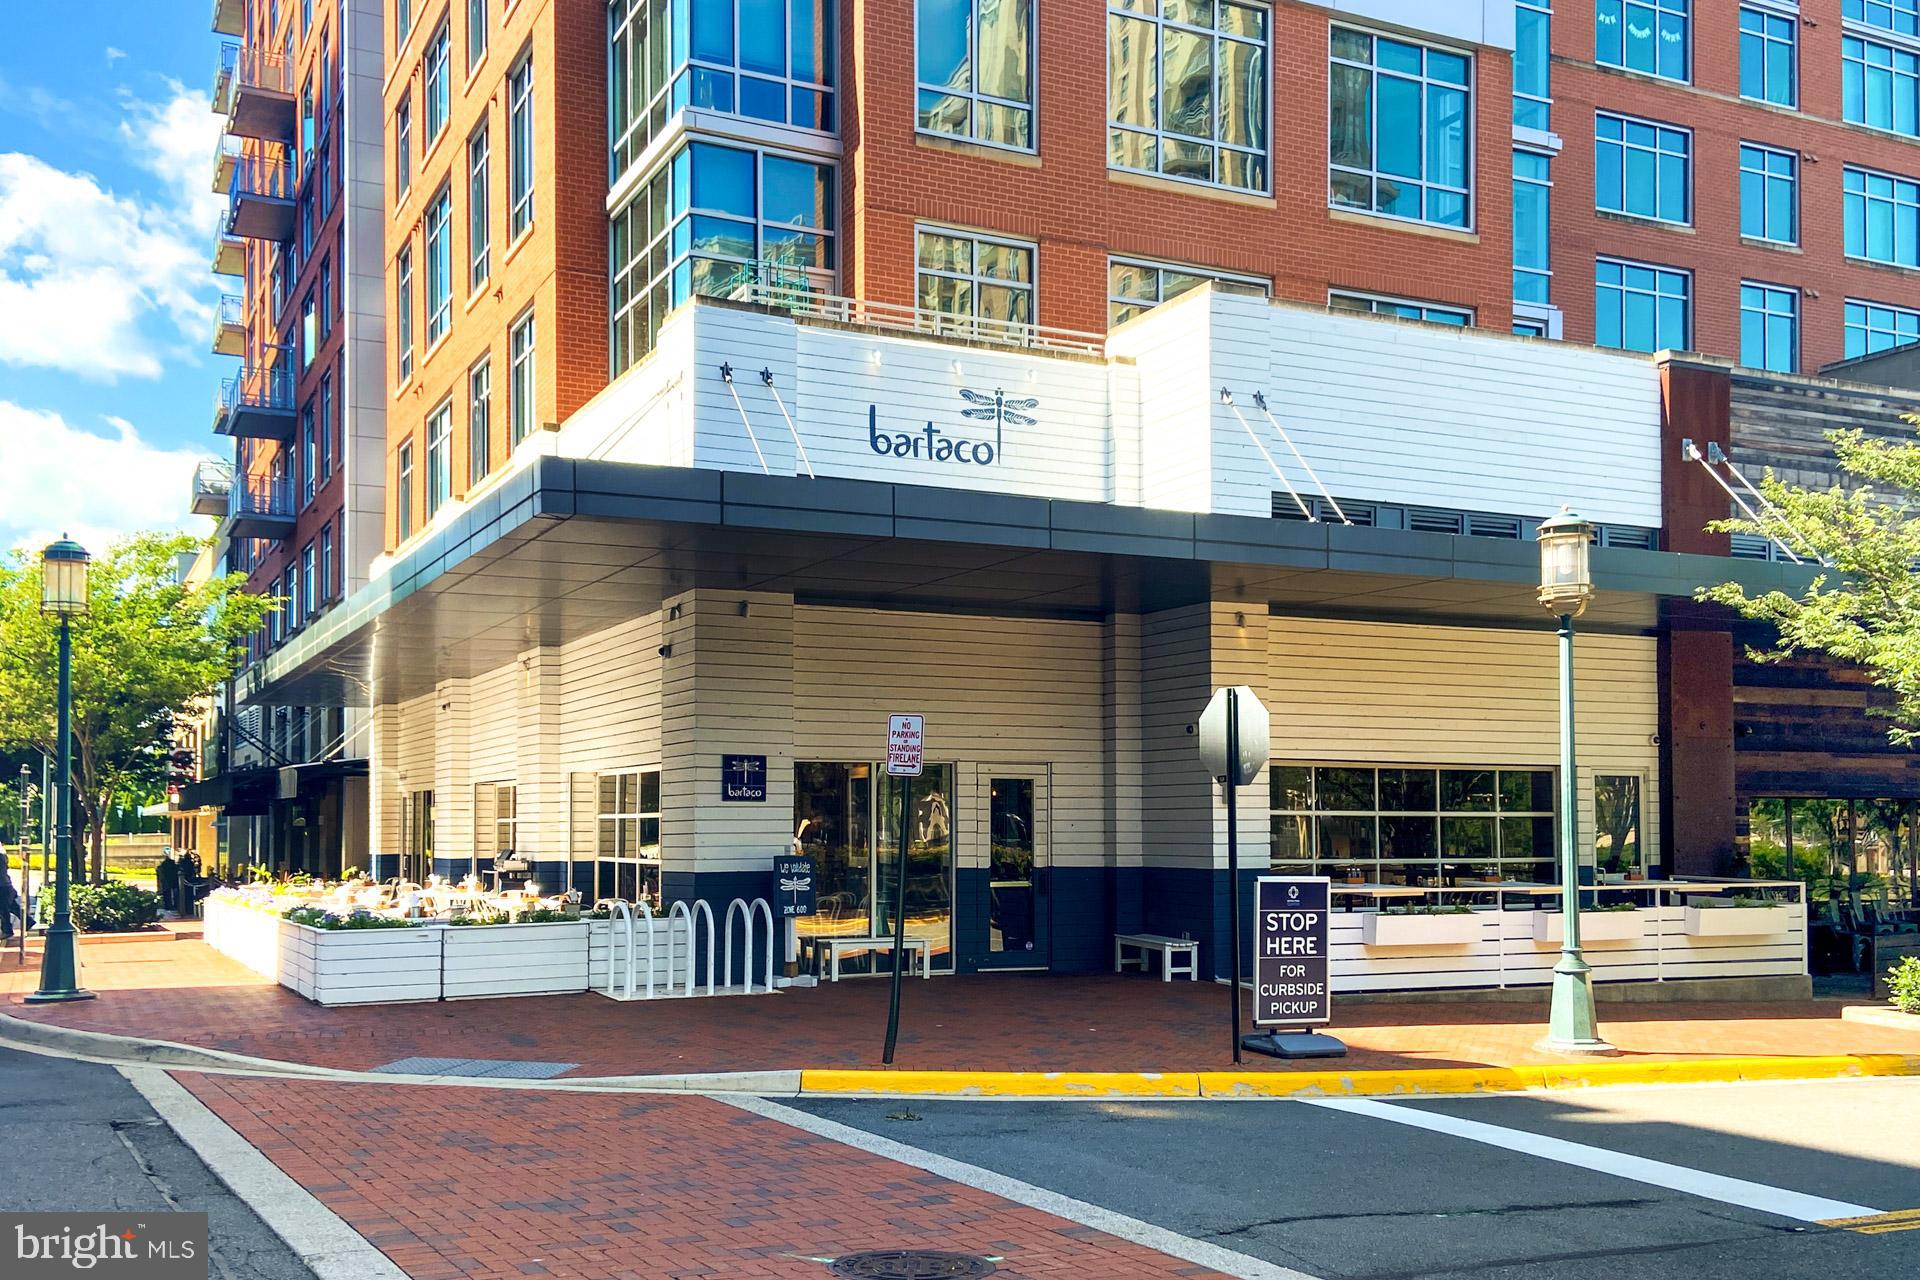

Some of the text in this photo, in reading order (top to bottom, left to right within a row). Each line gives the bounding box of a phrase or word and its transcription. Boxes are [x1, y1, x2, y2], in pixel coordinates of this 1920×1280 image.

[869, 404, 994, 465] bartaco
[901, 721, 911, 730] NO
[891, 730, 920, 739] PARKING
[889, 744, 921, 752] STANDING
[889, 753, 920, 763] FIRELANE
[728, 782, 762, 797] bartaco
[1266, 912, 1318, 932] STOP
[1266, 936, 1318, 956] HERE
[1279, 964, 1306, 978] FOR
[1260, 982, 1324, 997] CURBSIDE
[1270, 1001, 1318, 1015] PICKUP
